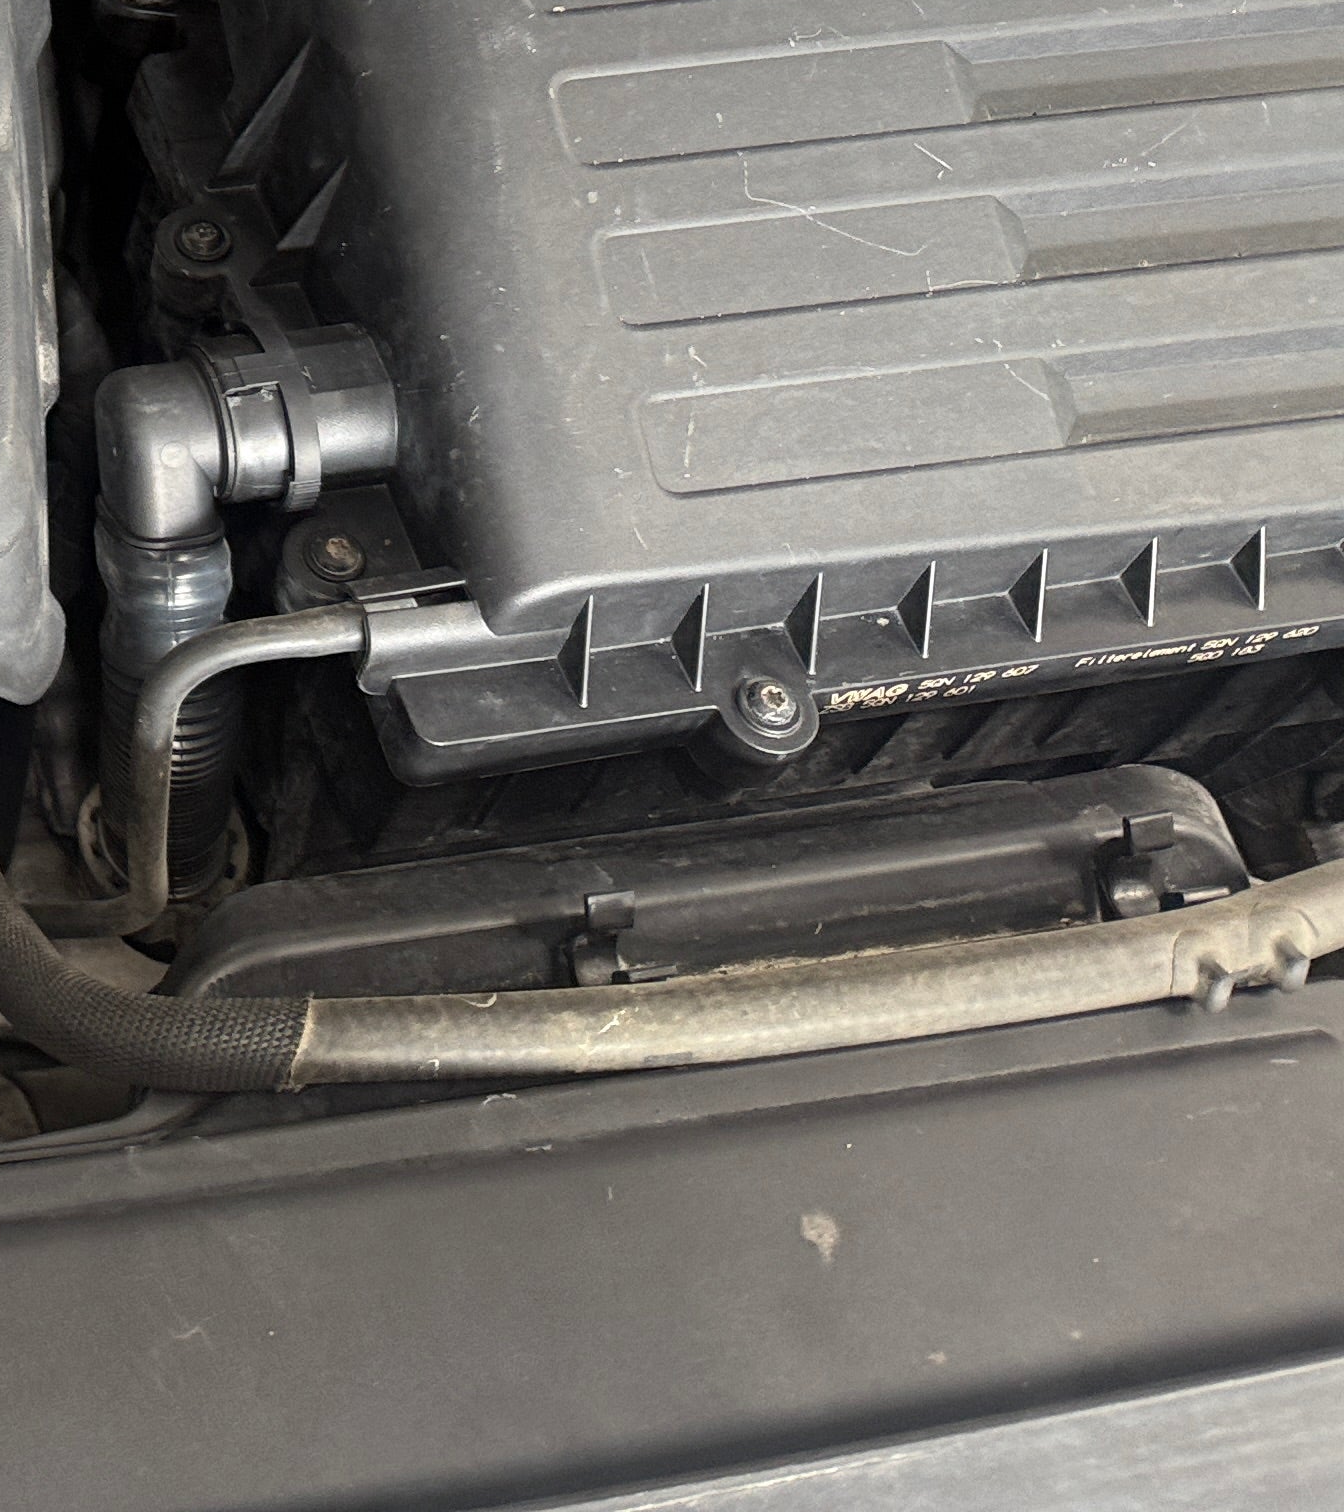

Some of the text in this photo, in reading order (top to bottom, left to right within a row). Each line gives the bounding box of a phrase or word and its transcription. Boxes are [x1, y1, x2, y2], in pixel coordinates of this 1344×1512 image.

[1075, 642, 1197, 668] Filterelement
[1245, 631, 1280, 645] 129
[831, 683, 910, 705] VWAG
[963, 670, 997, 684] 129
[905, 689, 939, 704] 129
